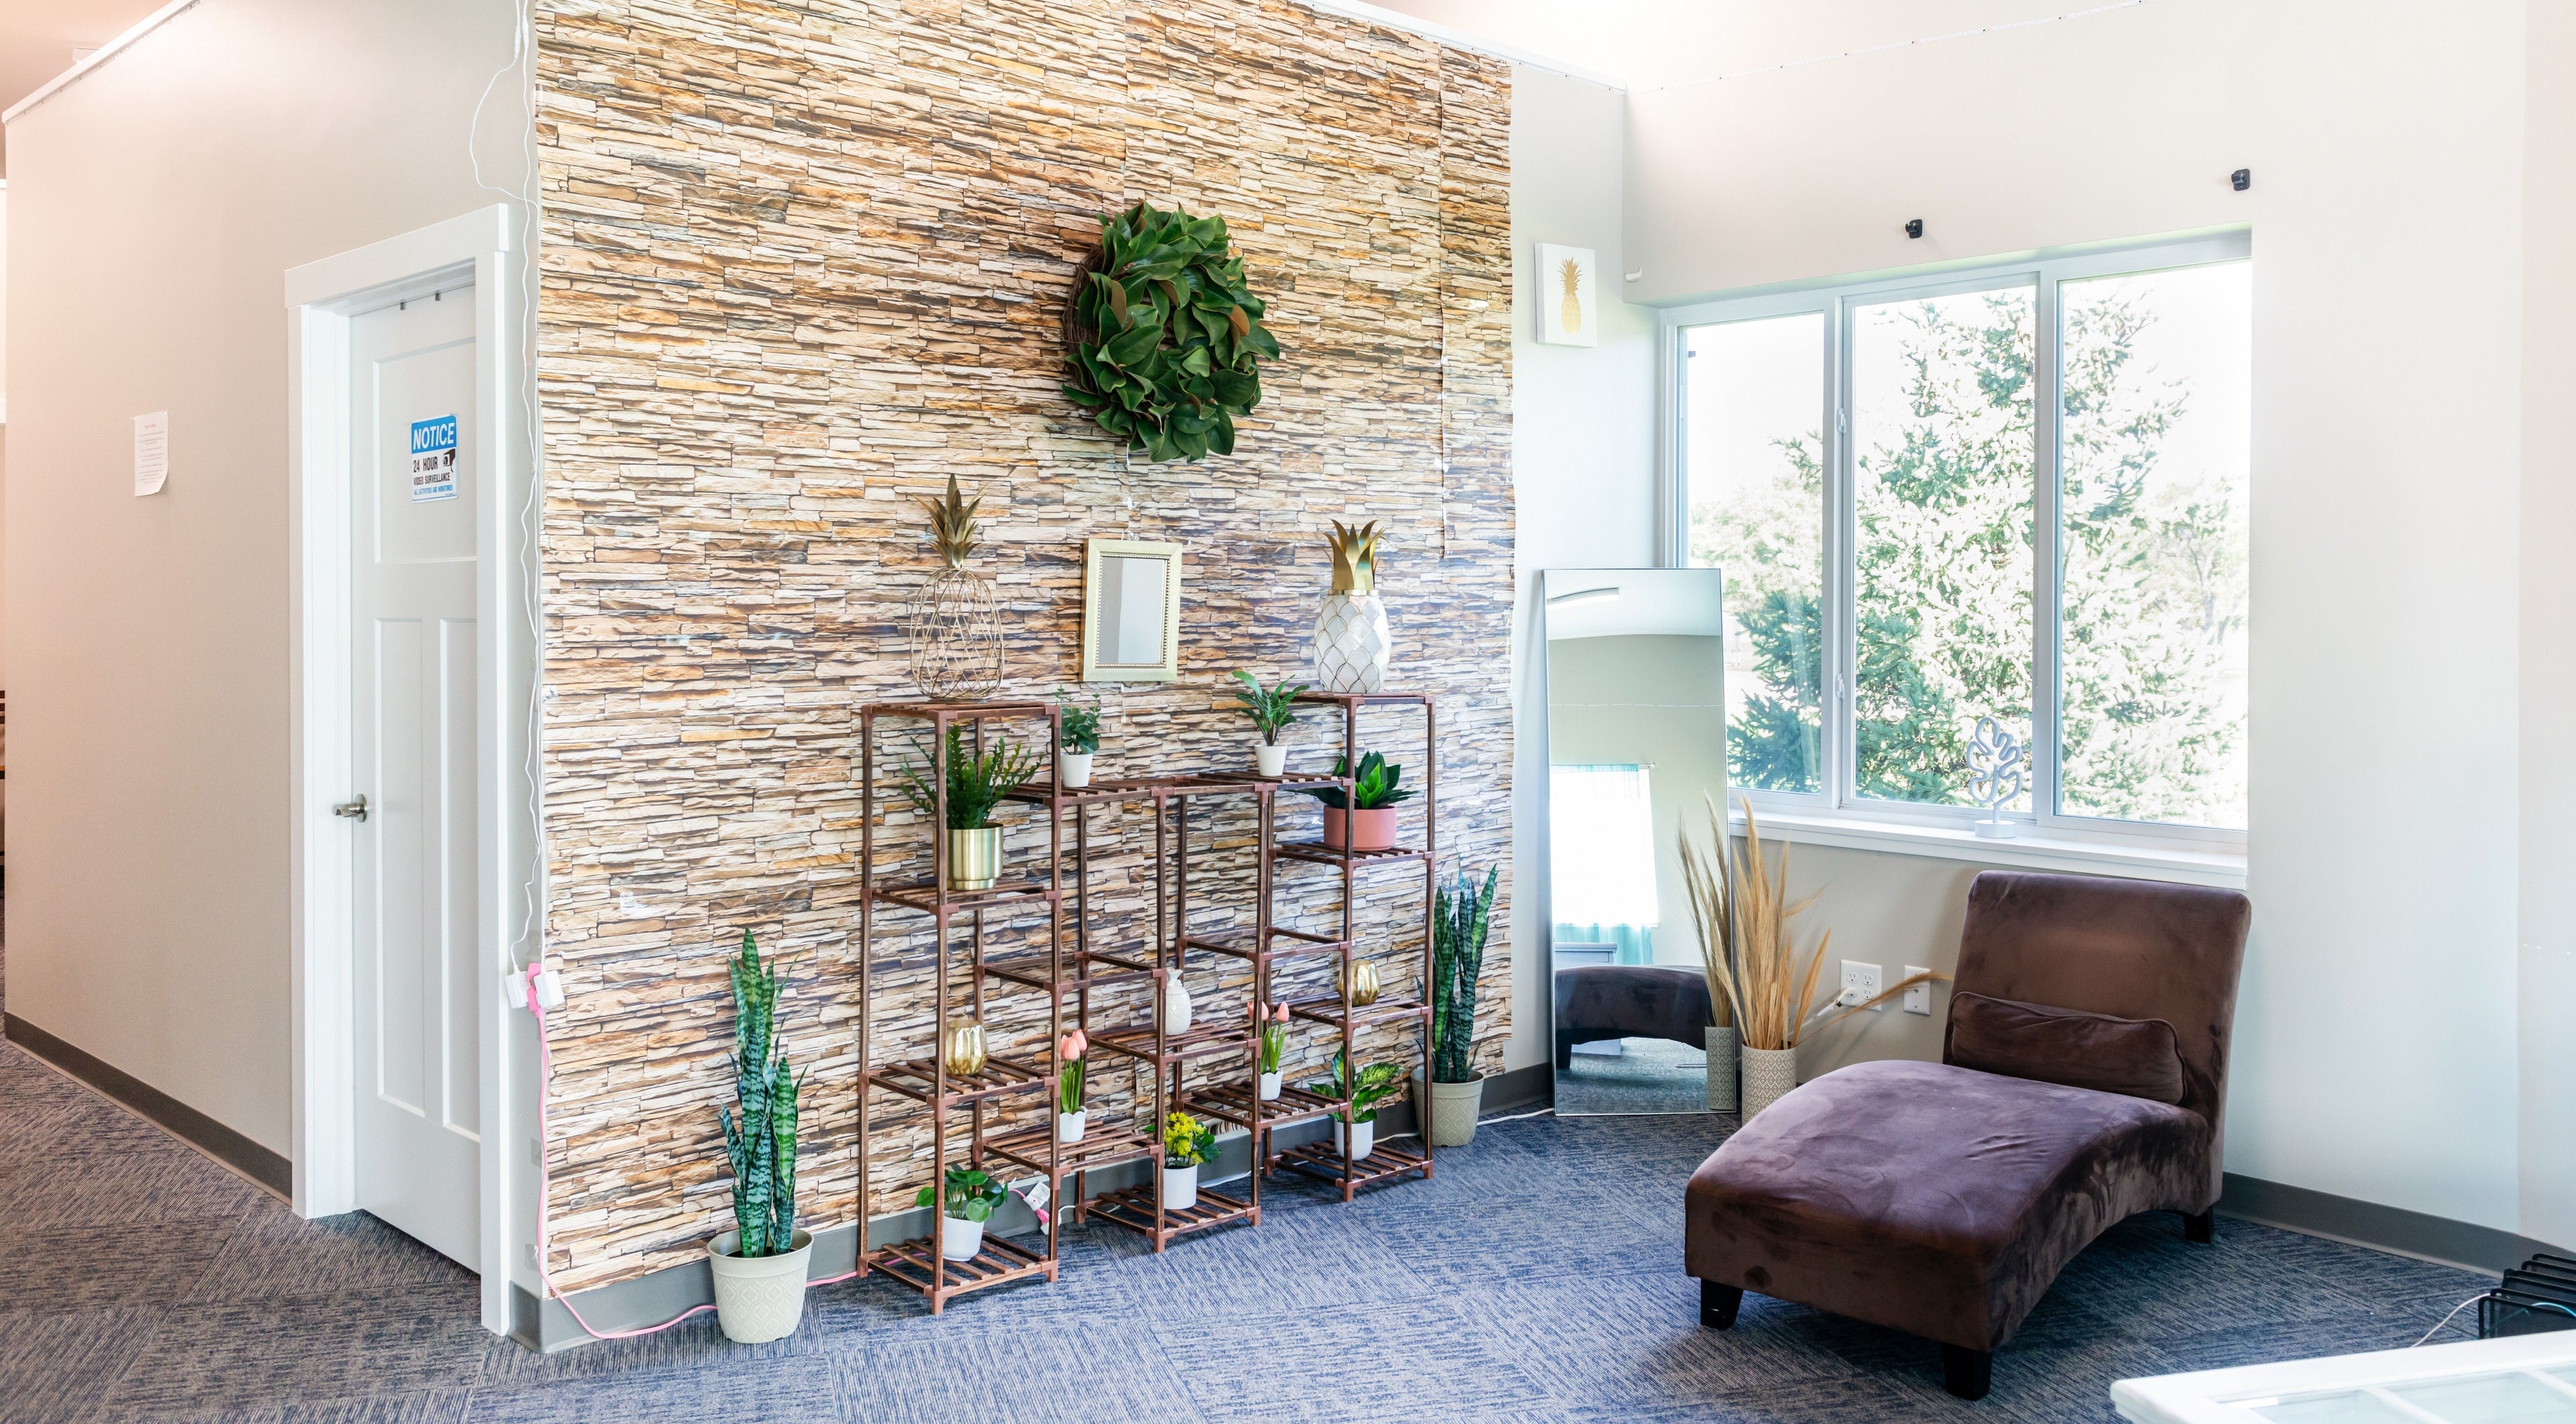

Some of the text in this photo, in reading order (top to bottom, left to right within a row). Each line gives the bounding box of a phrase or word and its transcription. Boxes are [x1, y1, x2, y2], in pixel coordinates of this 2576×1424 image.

[413, 423, 455, 450] NOTICE
[413, 456, 437, 472] 24 HOUR
[414, 472, 449, 486] VIDEO SURVEILLANCE
